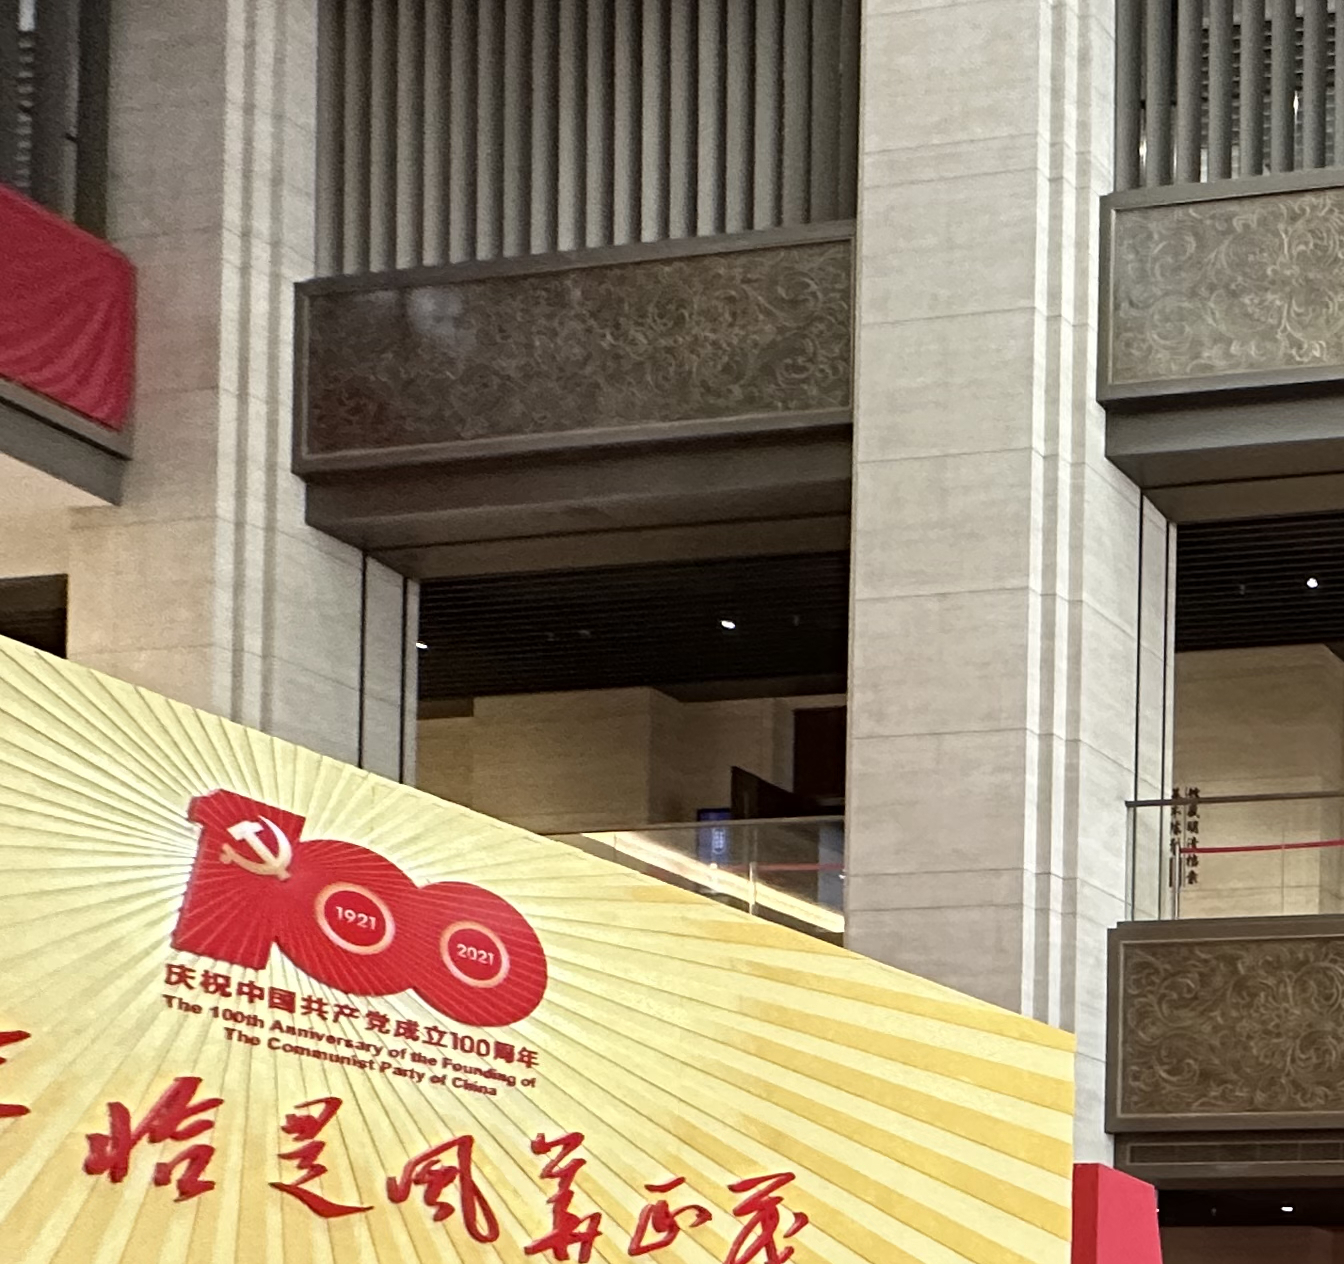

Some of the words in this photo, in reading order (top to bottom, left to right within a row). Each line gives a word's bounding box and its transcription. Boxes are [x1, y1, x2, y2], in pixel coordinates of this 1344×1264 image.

[336, 906, 377, 931] 1921
[456, 944, 495, 967] 2021
[163, 994, 203, 1014] The
[210, 1006, 264, 1028] 100th
[270, 1020, 383, 1056] Anniversary
[387, 1047, 407, 1060] of
[410, 1051, 438, 1067] the
[441, 1057, 517, 1087] Founding
[520, 1077, 537, 1088] of
[165, 963, 539, 1069] 庆祝中国共产党成立100周年
[224, 1027, 261, 1046] The
[267, 1037, 376, 1070] Communist
[379, 1061, 426, 1083] Party
[429, 1074, 448, 1086] of
[452, 1077, 498, 1096] China
